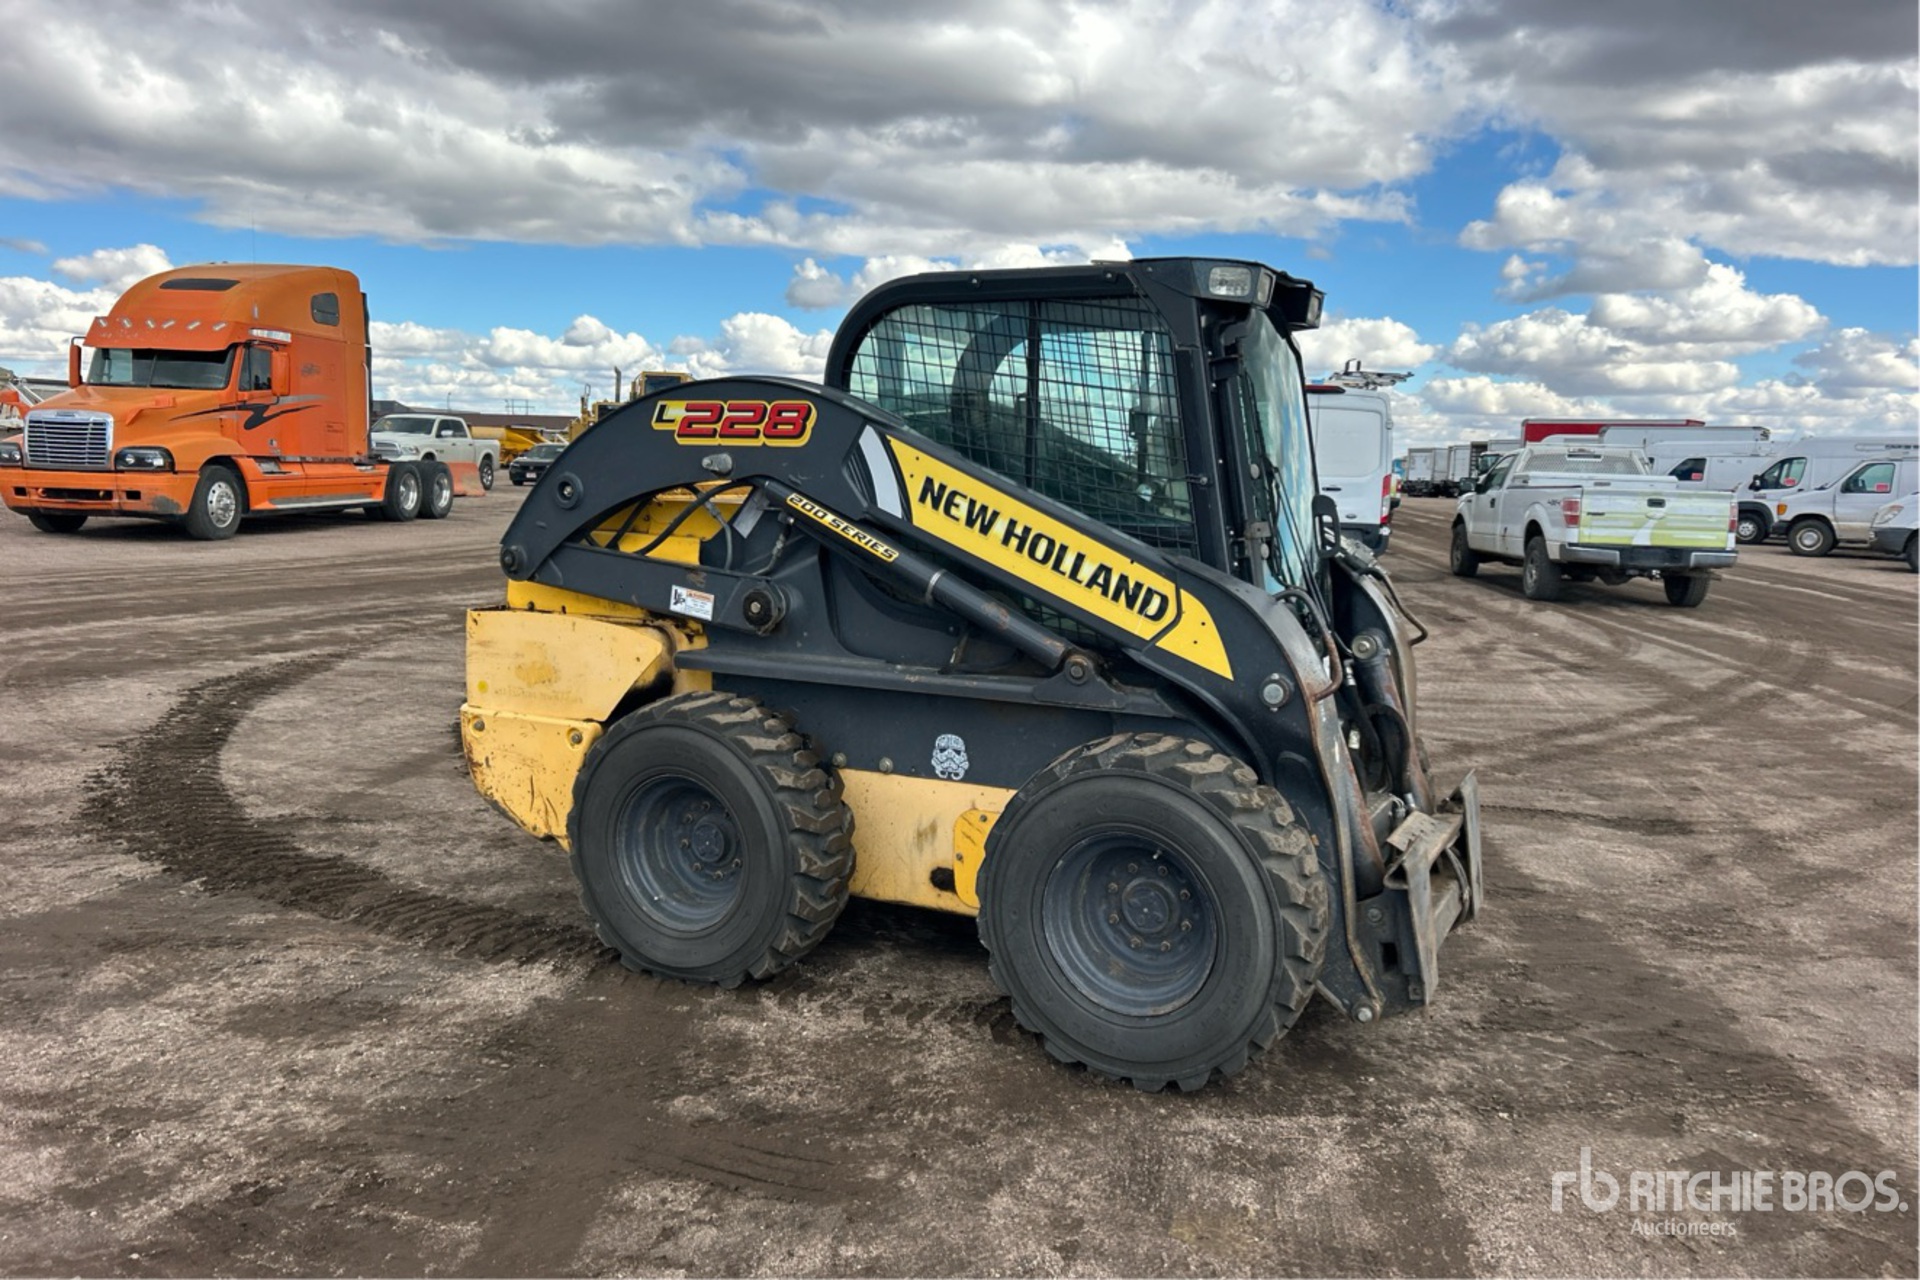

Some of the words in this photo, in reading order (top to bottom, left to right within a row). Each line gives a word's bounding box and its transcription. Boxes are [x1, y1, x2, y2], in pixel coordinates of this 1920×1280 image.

[789, 494, 828, 520] 200
[829, 518, 897, 559] SERIES
[918, 476, 1001, 536] NEW
[1001, 518, 1170, 623] HOLLAND
